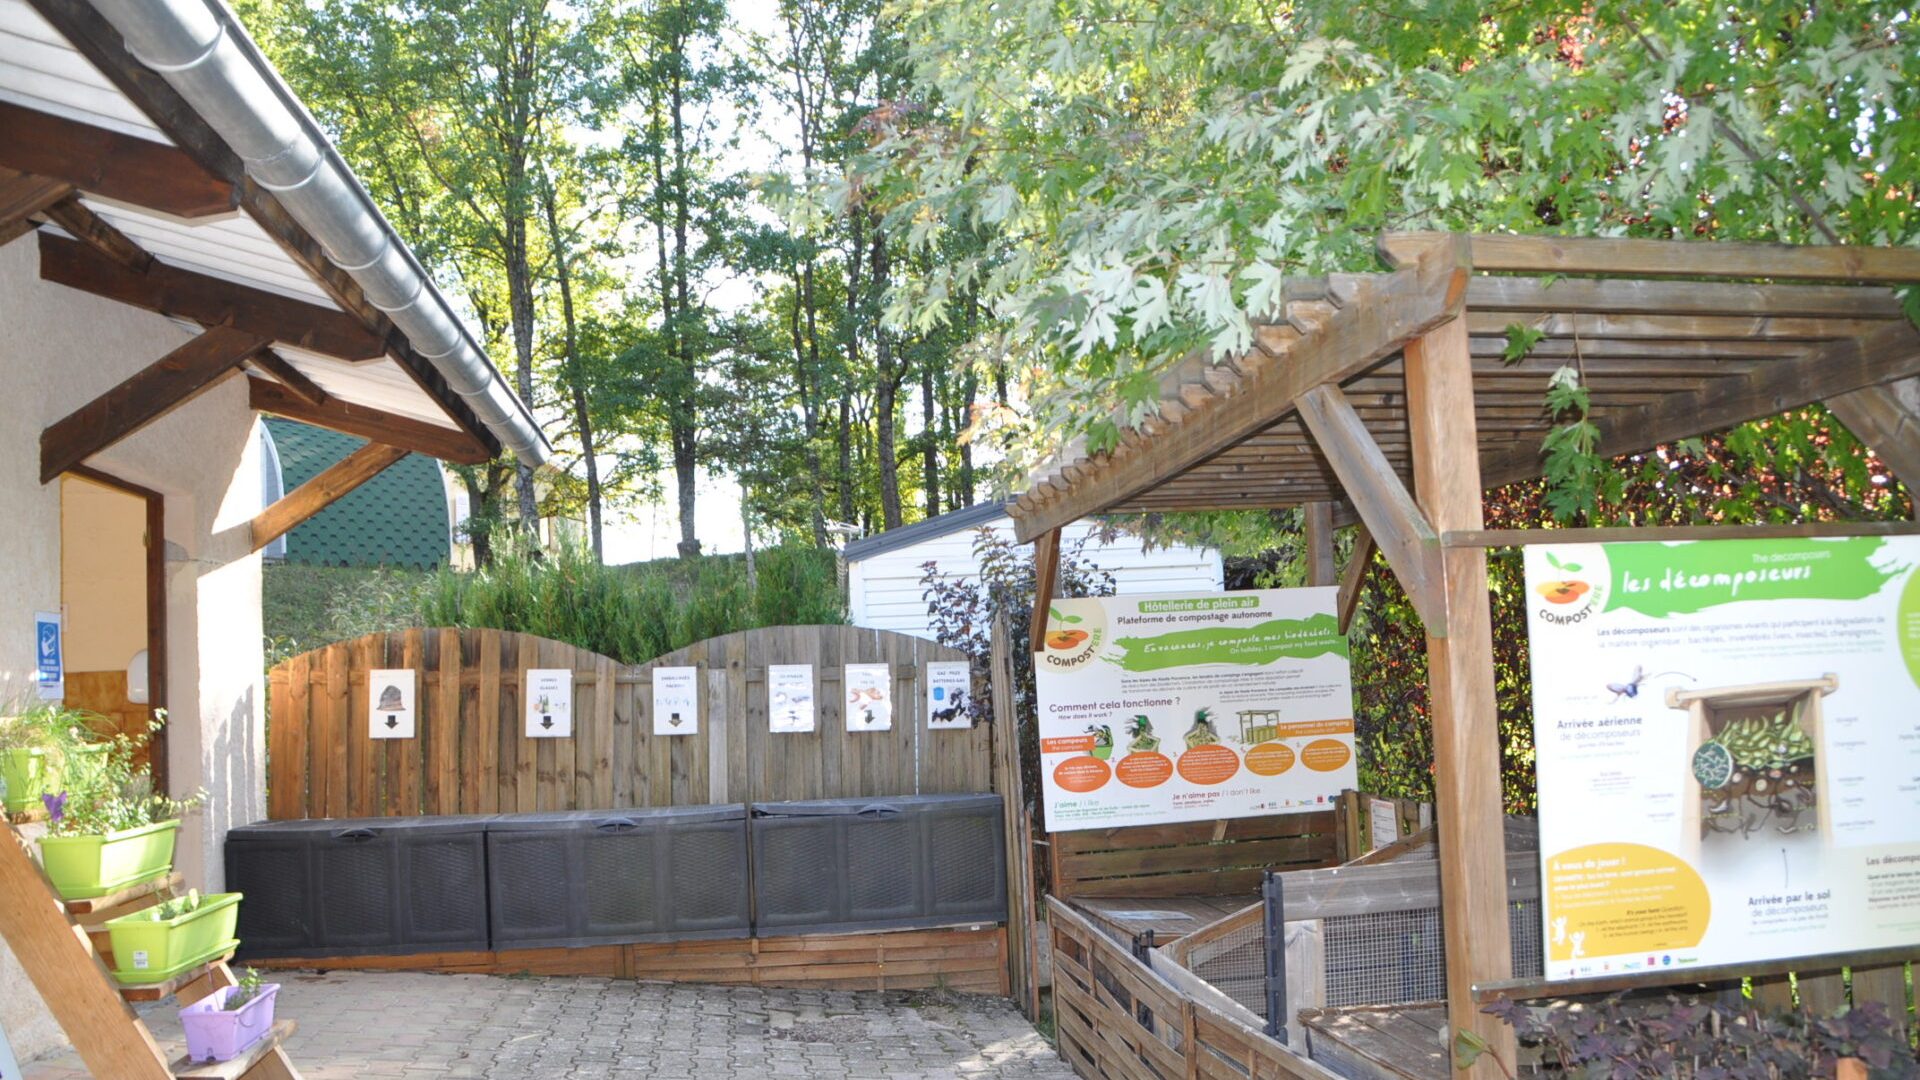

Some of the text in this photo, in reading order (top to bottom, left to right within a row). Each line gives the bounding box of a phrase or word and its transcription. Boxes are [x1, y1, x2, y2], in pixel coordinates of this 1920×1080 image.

[1752, 553, 1767, 563] The
[1623, 566, 1811, 597] les décomposeurs
[1144, 599, 1254, 612] Hôtellerie de plein air
[1117, 615, 1164, 625] Plateforme
[1179, 612, 1230, 624] compostage
[1232, 610, 1272, 619] autonome
[1612, 626, 1670, 636] décomposeurs
[1219, 636, 1260, 649] composte
[1264, 633, 1281, 642] mes
[1049, 696, 1181, 713] Comment cela fonctionne ?
[1557, 716, 1643, 728] Arrivée aérienne
[1748, 888, 1831, 906] Arrivée par le sol
